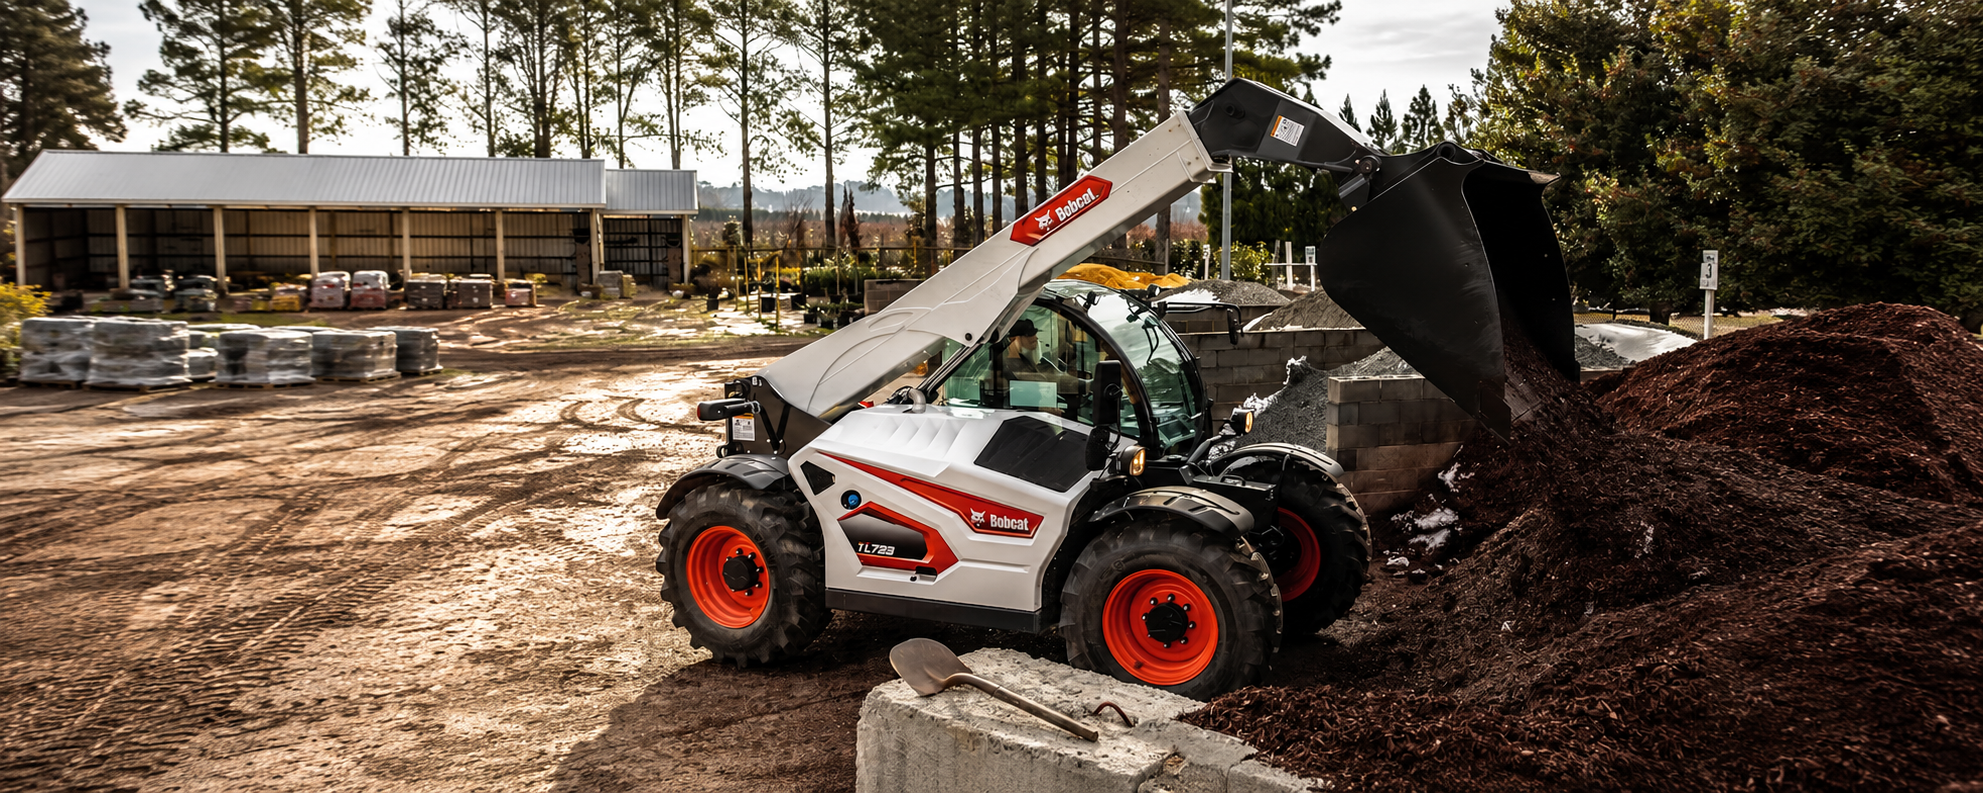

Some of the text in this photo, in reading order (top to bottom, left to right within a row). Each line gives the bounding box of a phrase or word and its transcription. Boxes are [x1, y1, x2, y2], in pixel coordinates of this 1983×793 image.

[1055, 188, 1096, 221] Bobcat
[1705, 263, 1712, 279] 3
[990, 514, 1029, 531] Bobcat
[858, 542, 895, 556] TL723
